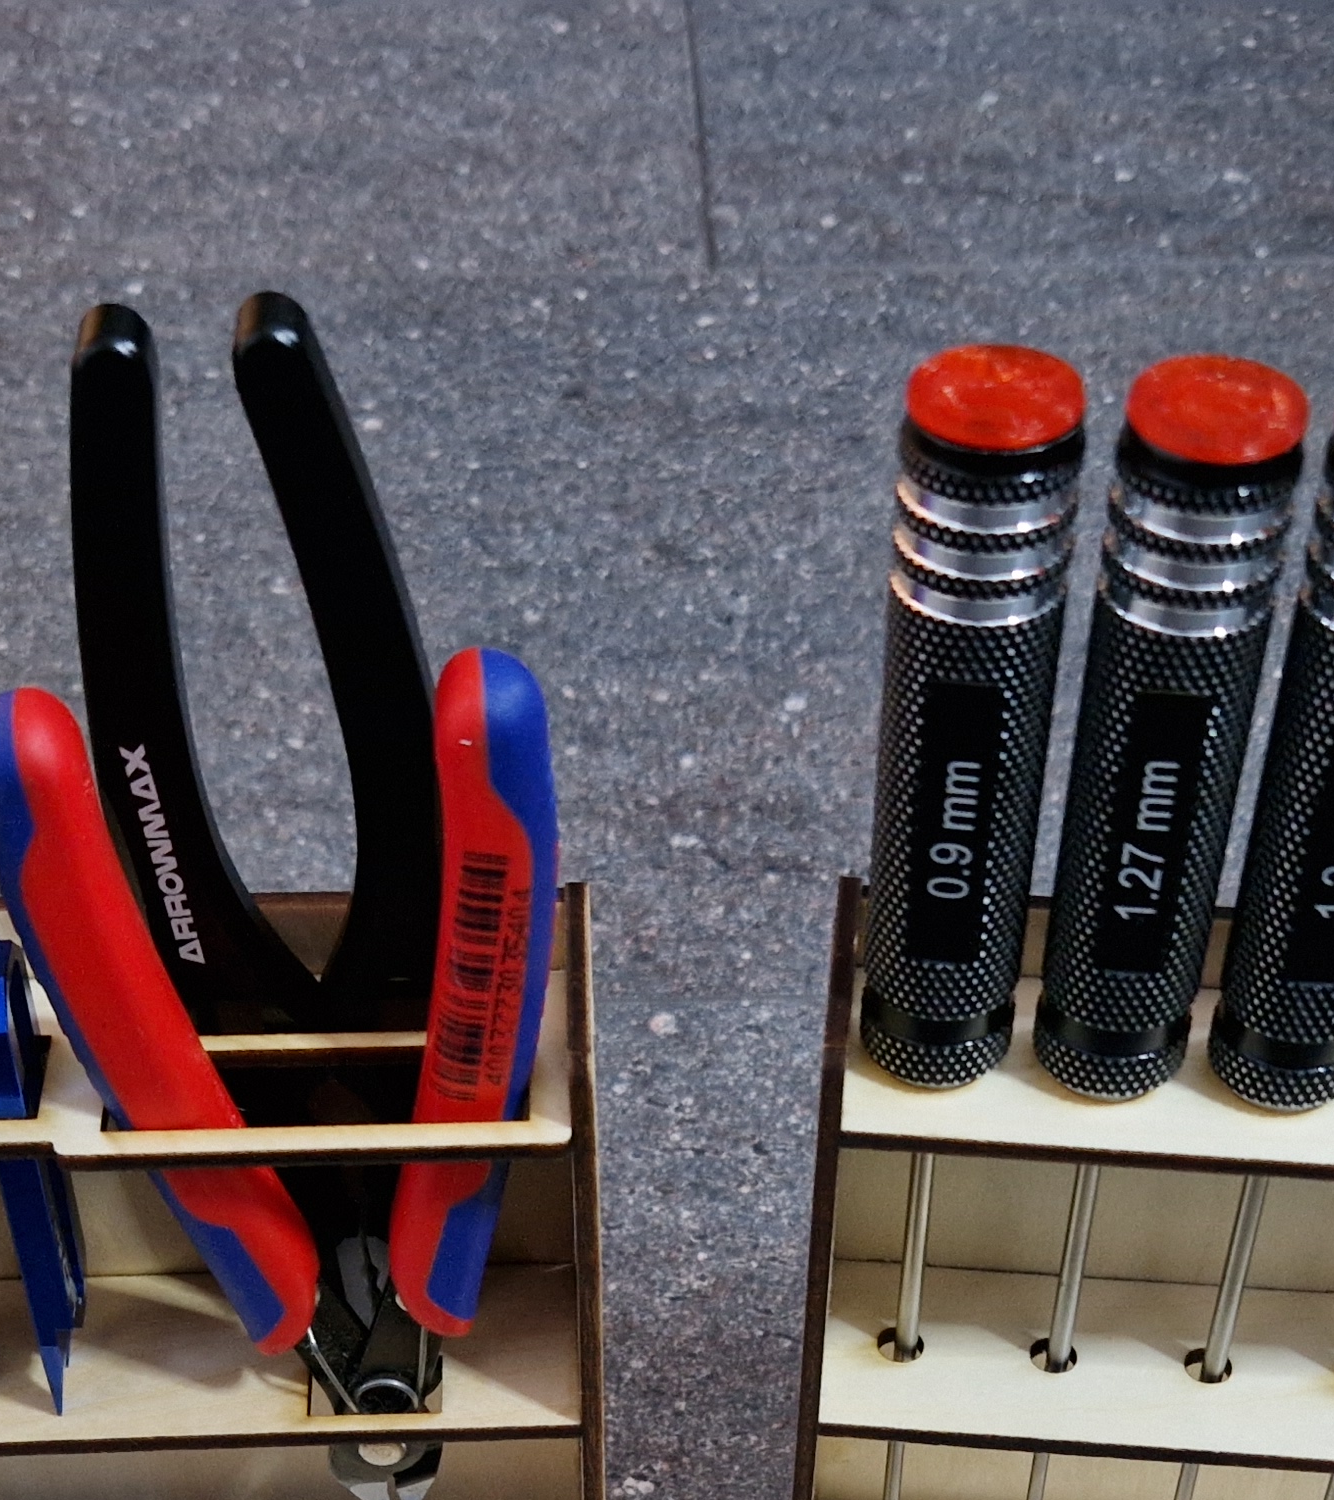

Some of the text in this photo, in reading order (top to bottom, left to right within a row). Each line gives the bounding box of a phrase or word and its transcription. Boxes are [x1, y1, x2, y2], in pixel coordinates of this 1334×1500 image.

[118, 743, 206, 965] ARROWMAX
[926, 760, 982, 899] 0.9 mm
[1113, 760, 1181, 920] 1.27 mm
